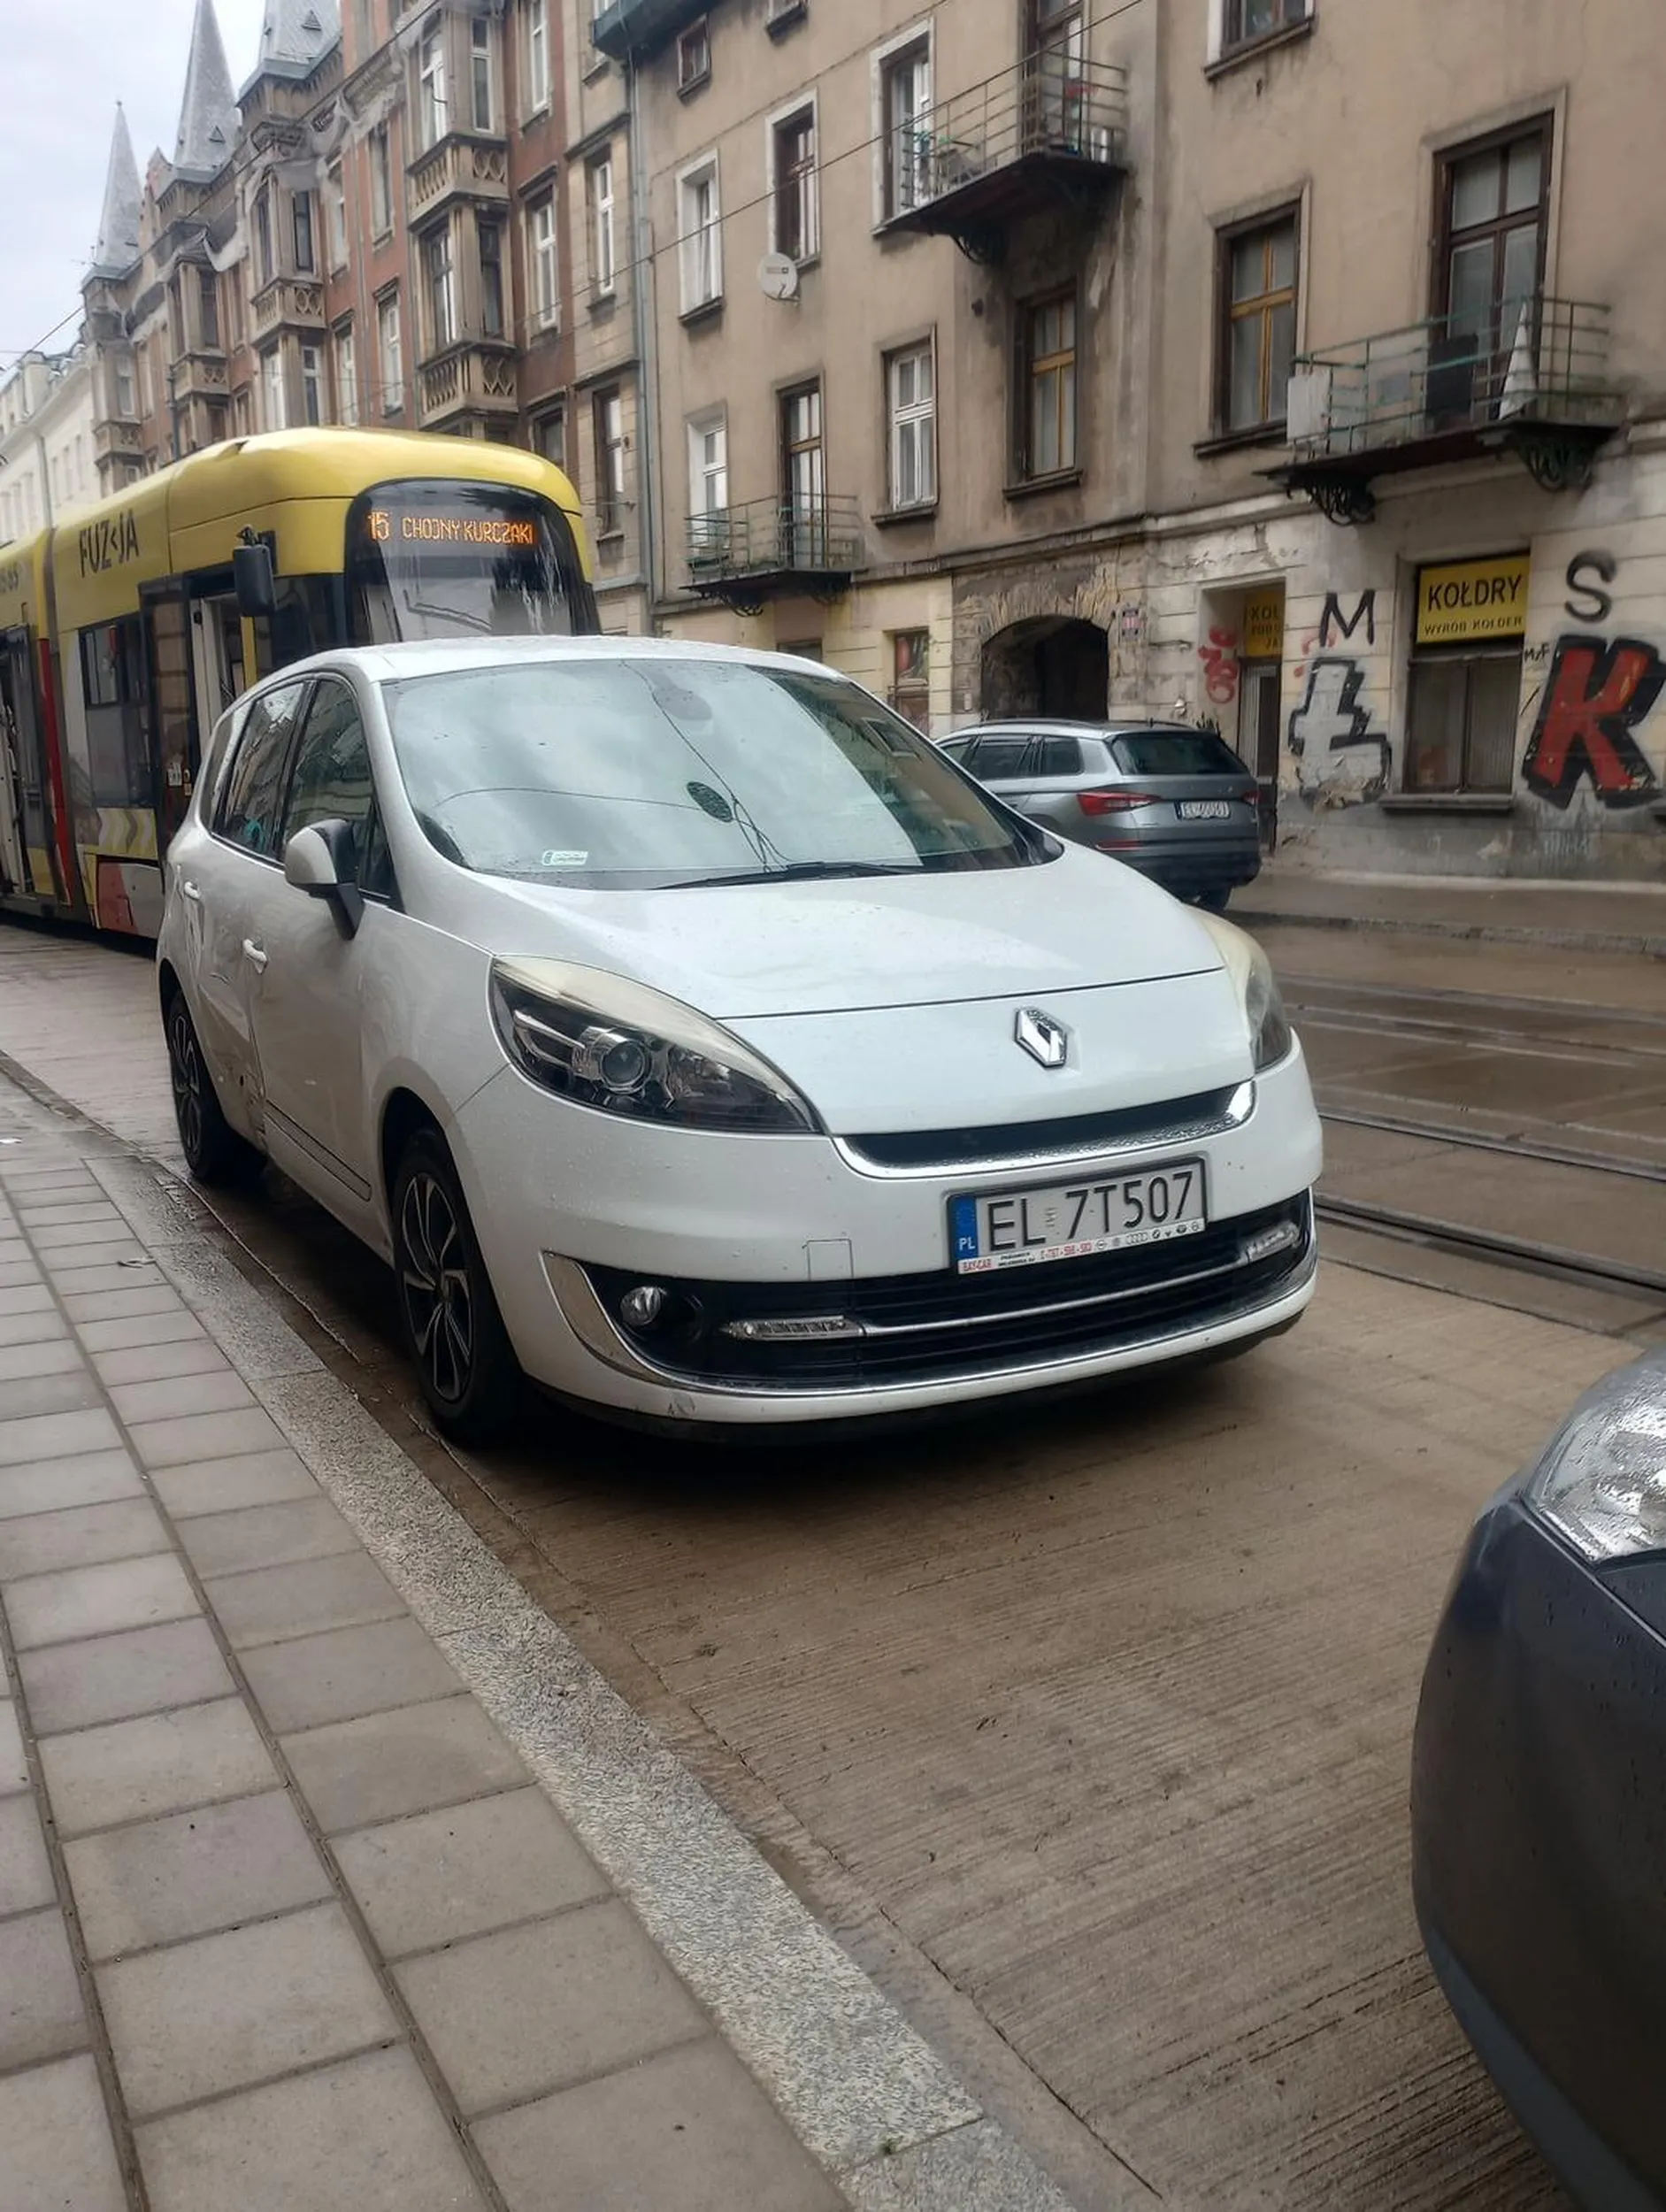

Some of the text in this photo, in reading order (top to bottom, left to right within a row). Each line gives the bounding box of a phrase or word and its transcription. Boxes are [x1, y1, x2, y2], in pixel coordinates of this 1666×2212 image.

[367, 511, 534, 545] 15 CHOJNY KURCZAKI
[1428, 574, 1522, 612] KOŁDRY
[987, 1171, 1193, 1251] EL 7T507
[959, 1237, 975, 1251] PL
